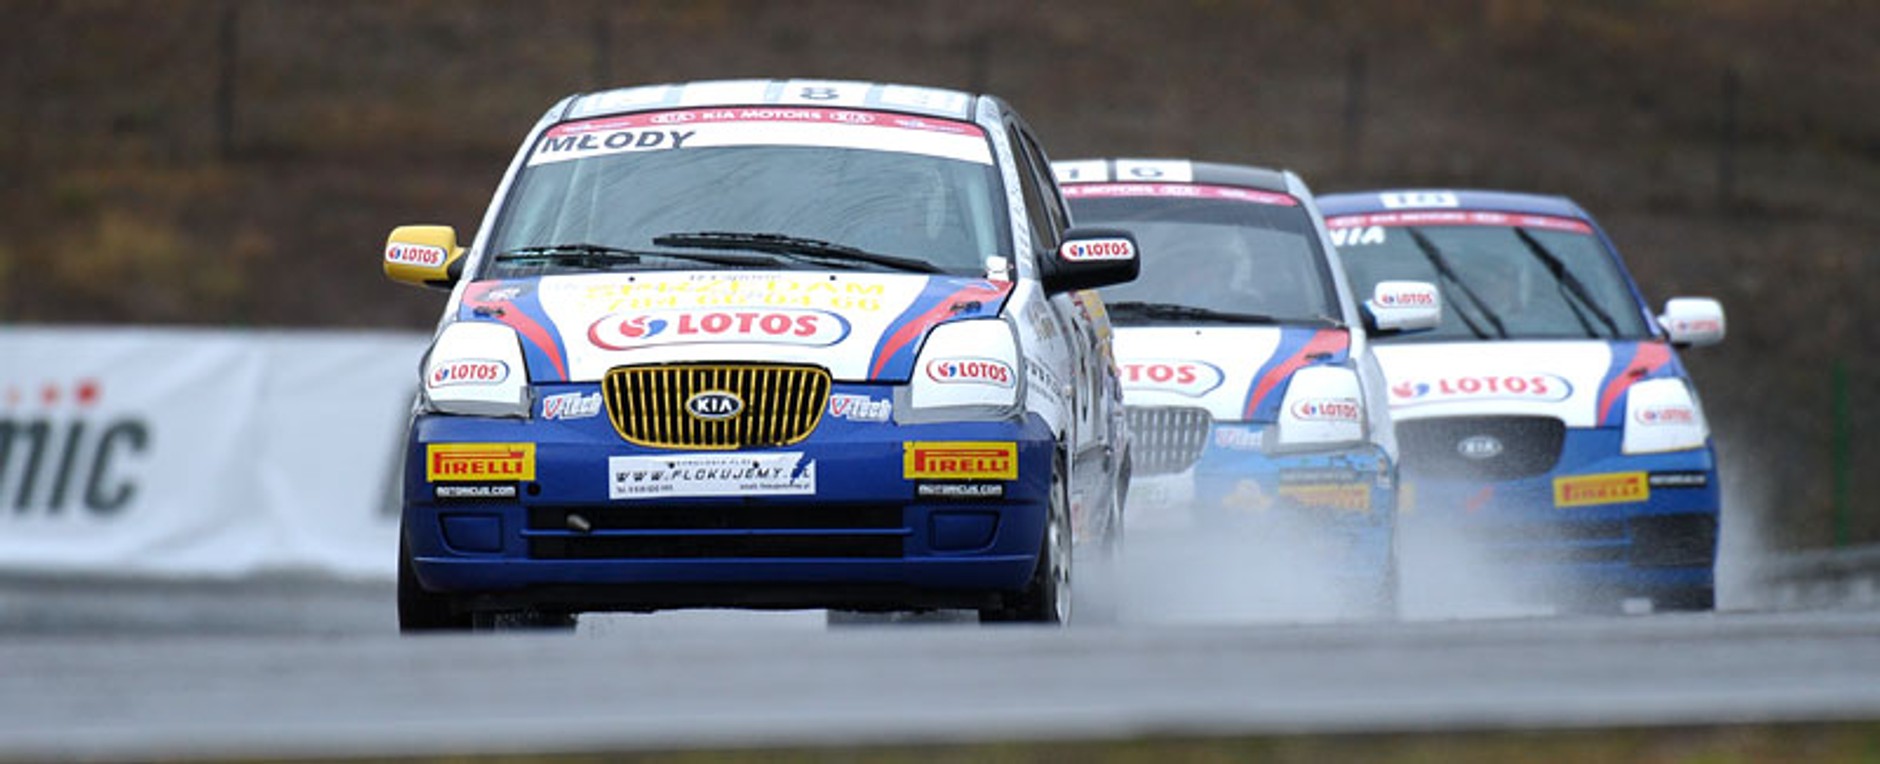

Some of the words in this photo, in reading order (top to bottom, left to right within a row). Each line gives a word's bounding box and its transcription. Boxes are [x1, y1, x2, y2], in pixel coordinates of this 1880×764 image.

[801, 86, 839, 100] 8
[702, 110, 735, 119] KIA
[739, 109, 822, 120] MOTORS
[541, 131, 696, 153] MŁODY
[402, 247, 440, 264] LOTOS
[1086, 242, 1129, 256] LOTOS
[1396, 292, 1433, 304] LOTOS
[677, 312, 819, 337] LOTOS
[451, 364, 499, 380] LOTOS
[959, 362, 1008, 383] LOTOS
[1116, 364, 1197, 385] TOS
[1440, 376, 1548, 395] LOTOS
[697, 399, 733, 412] KIA
[1319, 402, 1358, 419] LOTOS
[433, 452, 525, 475] PIRELLI
[914, 449, 1009, 472] PIRELLI
[615, 466, 811, 483] WWW.FLOKUJEMY.L
